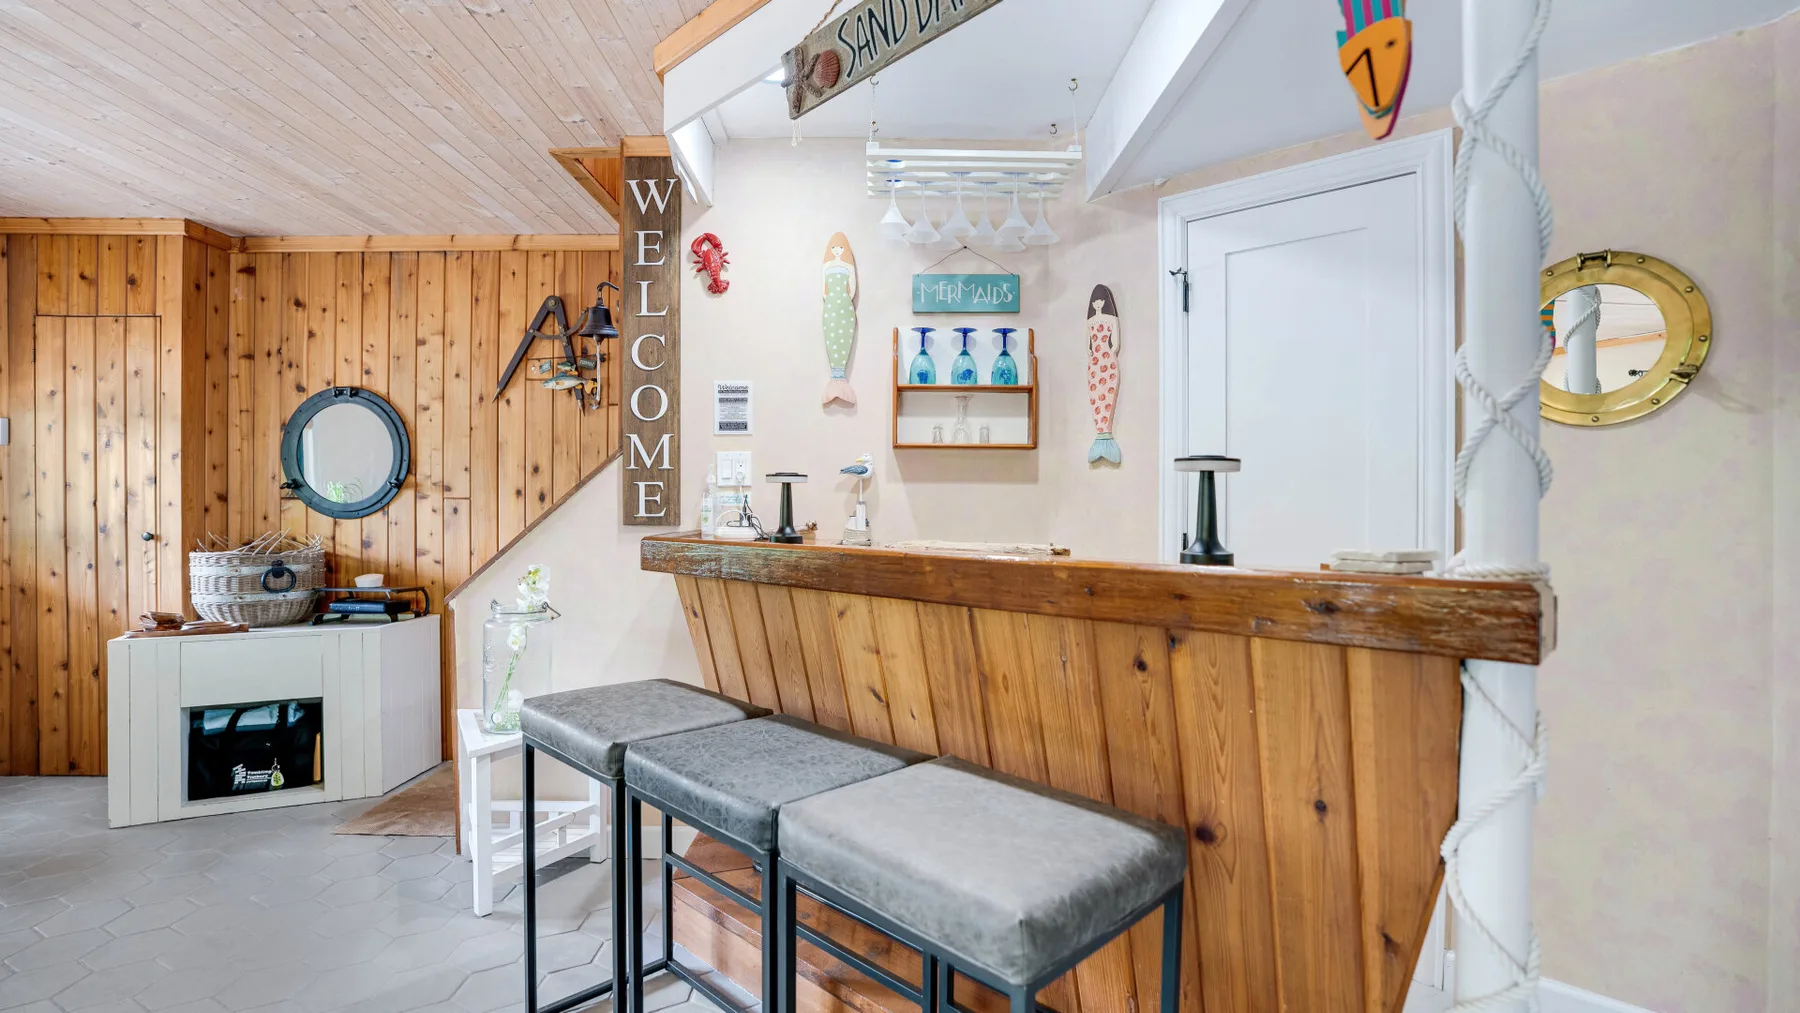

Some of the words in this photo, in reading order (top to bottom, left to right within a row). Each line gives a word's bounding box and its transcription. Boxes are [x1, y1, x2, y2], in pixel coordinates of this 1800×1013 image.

[837, 0, 908, 79] SAND
[920, 281, 1013, 305] MERMAIDS
[625, 179, 678, 517] WELCOME
